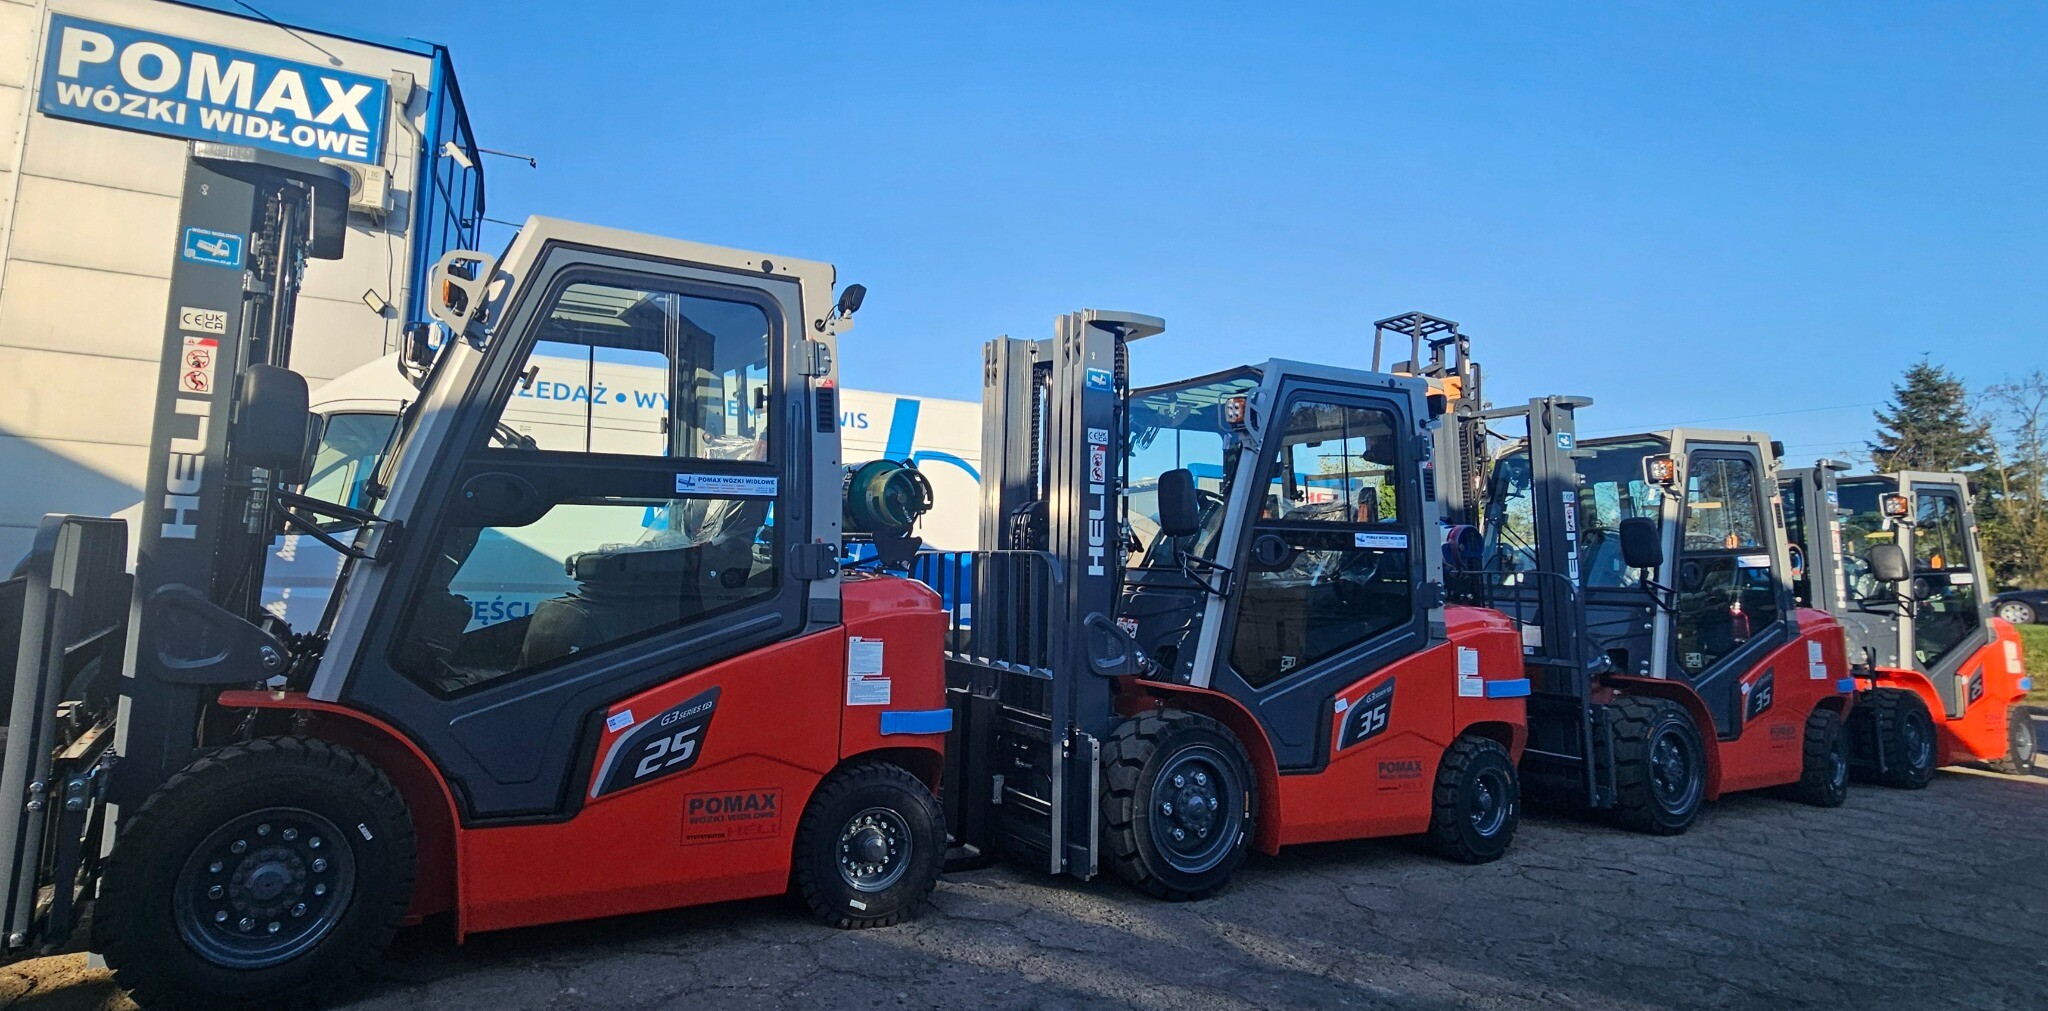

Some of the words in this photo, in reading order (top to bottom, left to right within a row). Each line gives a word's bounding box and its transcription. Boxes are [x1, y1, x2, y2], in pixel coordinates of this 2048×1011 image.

[57, 26, 373, 133] POMAX
[56, 81, 187, 126] WÓZKI
[200, 107, 369, 158] WIDŁOWE
[160, 398, 212, 540] HELI
[1088, 483, 1106, 576] HELI
[466, 595, 530, 625] ĘŚCI
[1755, 686, 1771, 713] 35
[660, 710, 680, 727] G3
[1357, 703, 1388, 739] 35
[634, 725, 702, 779] 25
[1378, 760, 1422, 774] POMAX
[688, 793, 777, 816] POMAX
